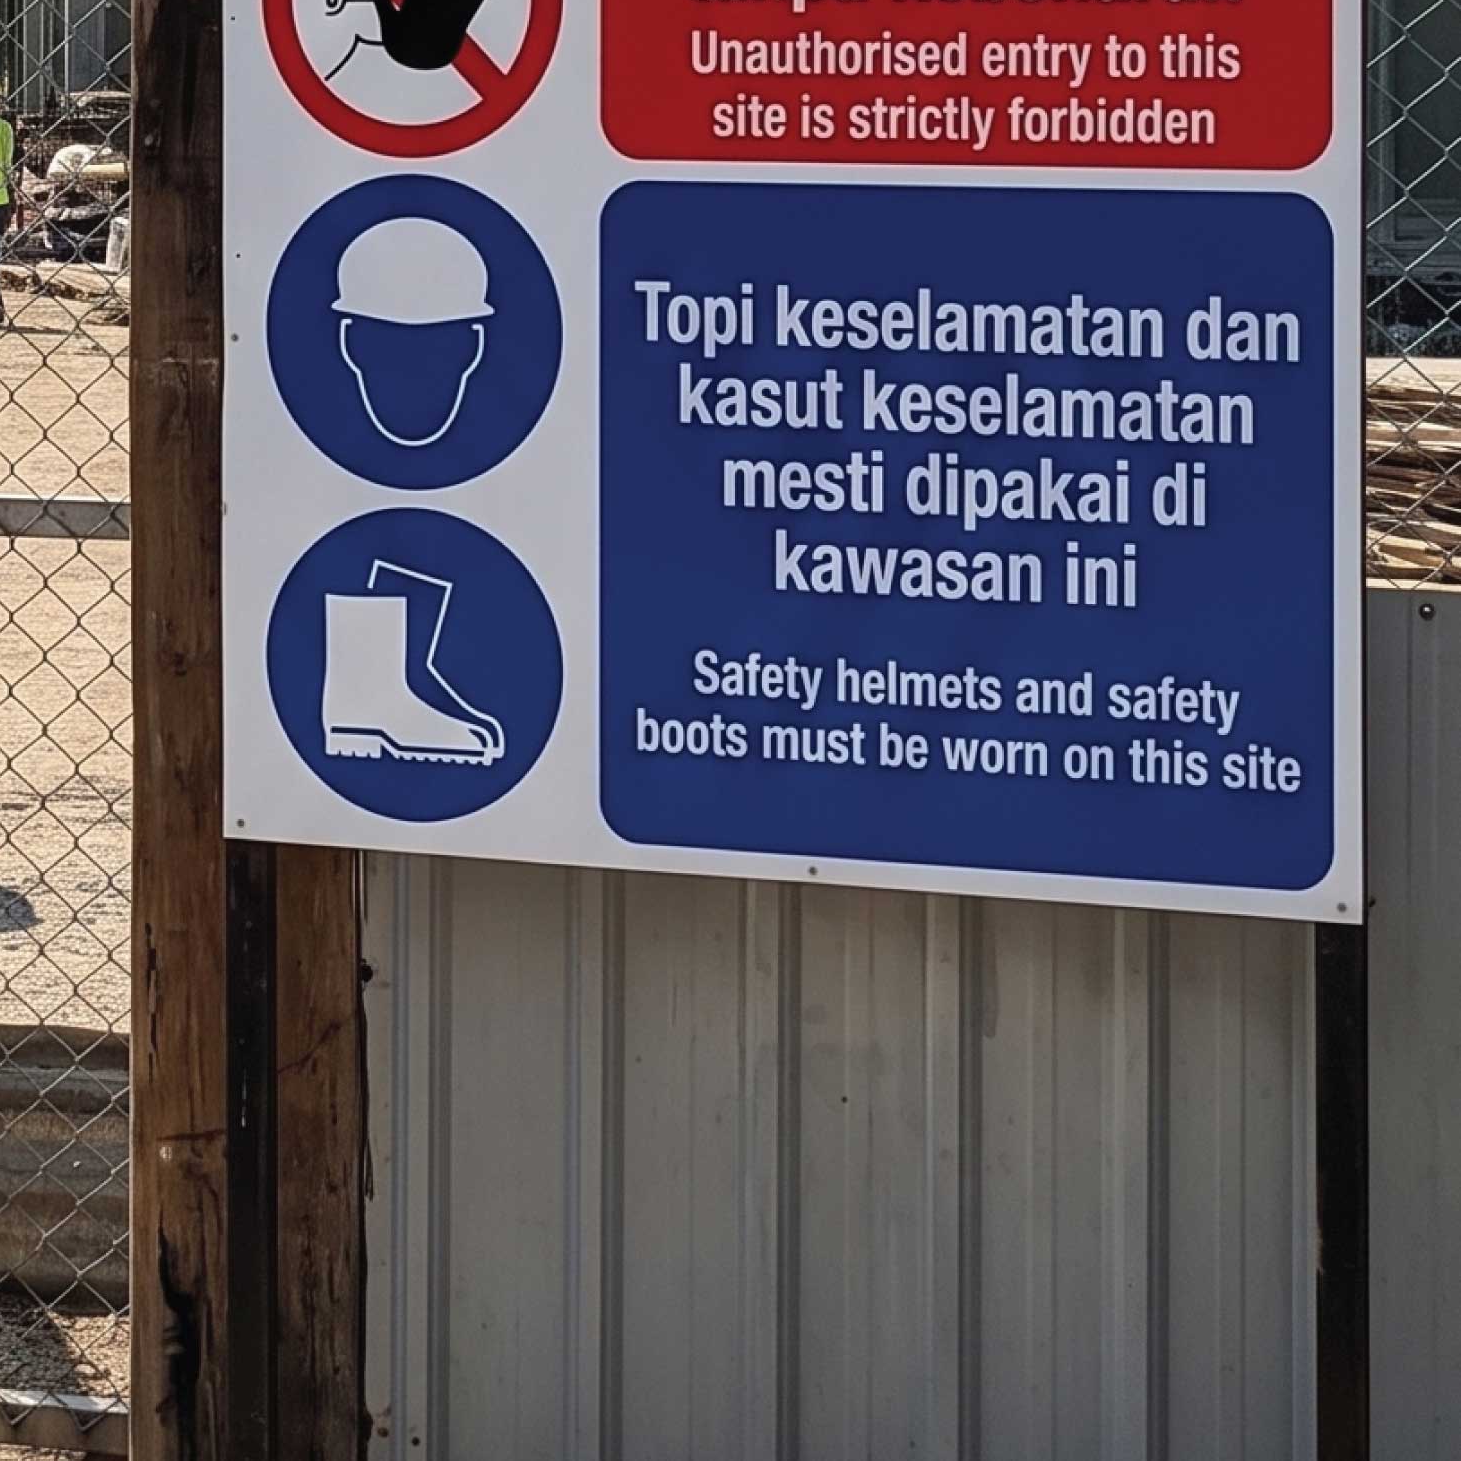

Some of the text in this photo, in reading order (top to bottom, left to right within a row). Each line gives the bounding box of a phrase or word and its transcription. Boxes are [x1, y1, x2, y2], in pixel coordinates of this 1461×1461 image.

[691, 30, 1240, 88] Unauthorised entry to this
[713, 93, 1215, 151] site is strictly forbidden
[634, 280, 1299, 362] Topi keselamatan dan
[680, 363, 1254, 444] kasut keselamatan
[723, 449, 1206, 531] mesti dipakai di
[775, 529, 1136, 607] kawasan ini
[694, 650, 1240, 736] Safety helmets and safety
[637, 707, 1301, 793] boots must be worn on this site
